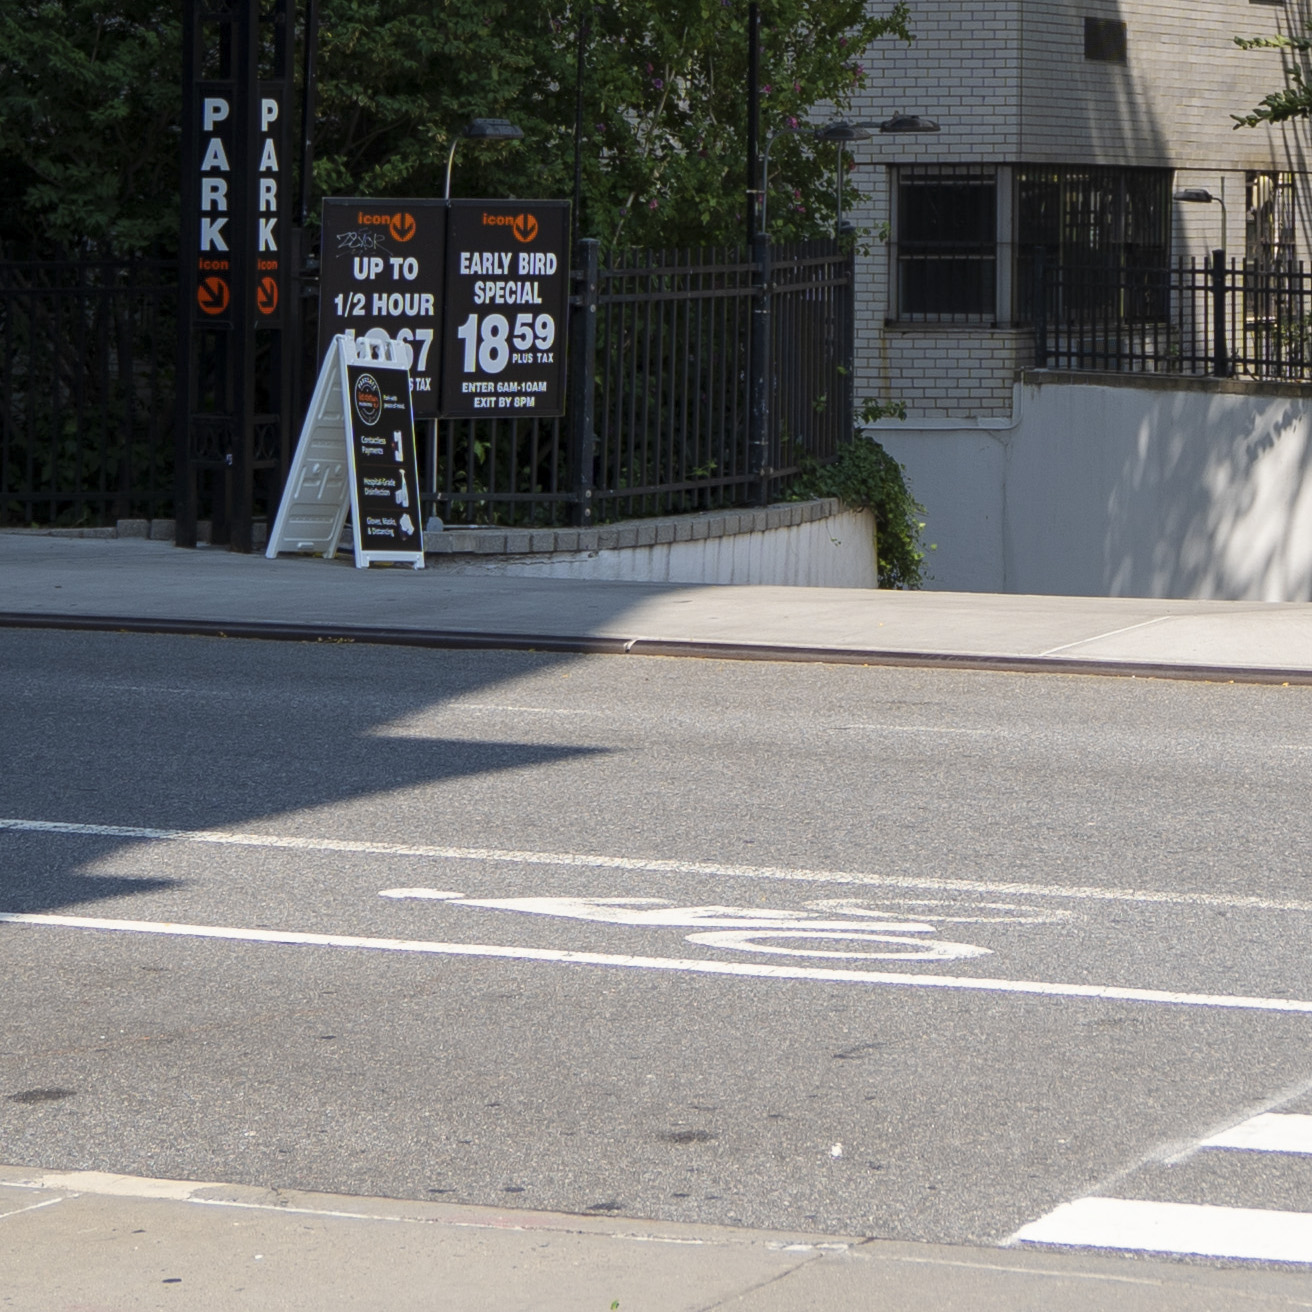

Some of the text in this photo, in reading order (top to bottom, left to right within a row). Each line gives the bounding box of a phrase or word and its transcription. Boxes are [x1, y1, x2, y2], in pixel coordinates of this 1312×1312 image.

[200, 97, 230, 251] PARK
[258, 98, 279, 251] PARK
[358, 212, 391, 225] icon
[482, 213, 514, 226] icon
[199, 257, 229, 270] icon
[257, 258, 278, 271] icon
[353, 257, 419, 280] UP TO
[460, 252, 557, 275] EARLY BIRD
[474, 281, 542, 304] SPECIAL
[334, 292, 434, 317] 1/2 HOUR
[512, 352, 554, 364] PLUS TAX
[415, 377, 432, 391] TAX
[462, 382, 495, 393] ENTER
[474, 397, 535, 408] EXIT BY 8PM
[361, 445, 384, 455] Payments
